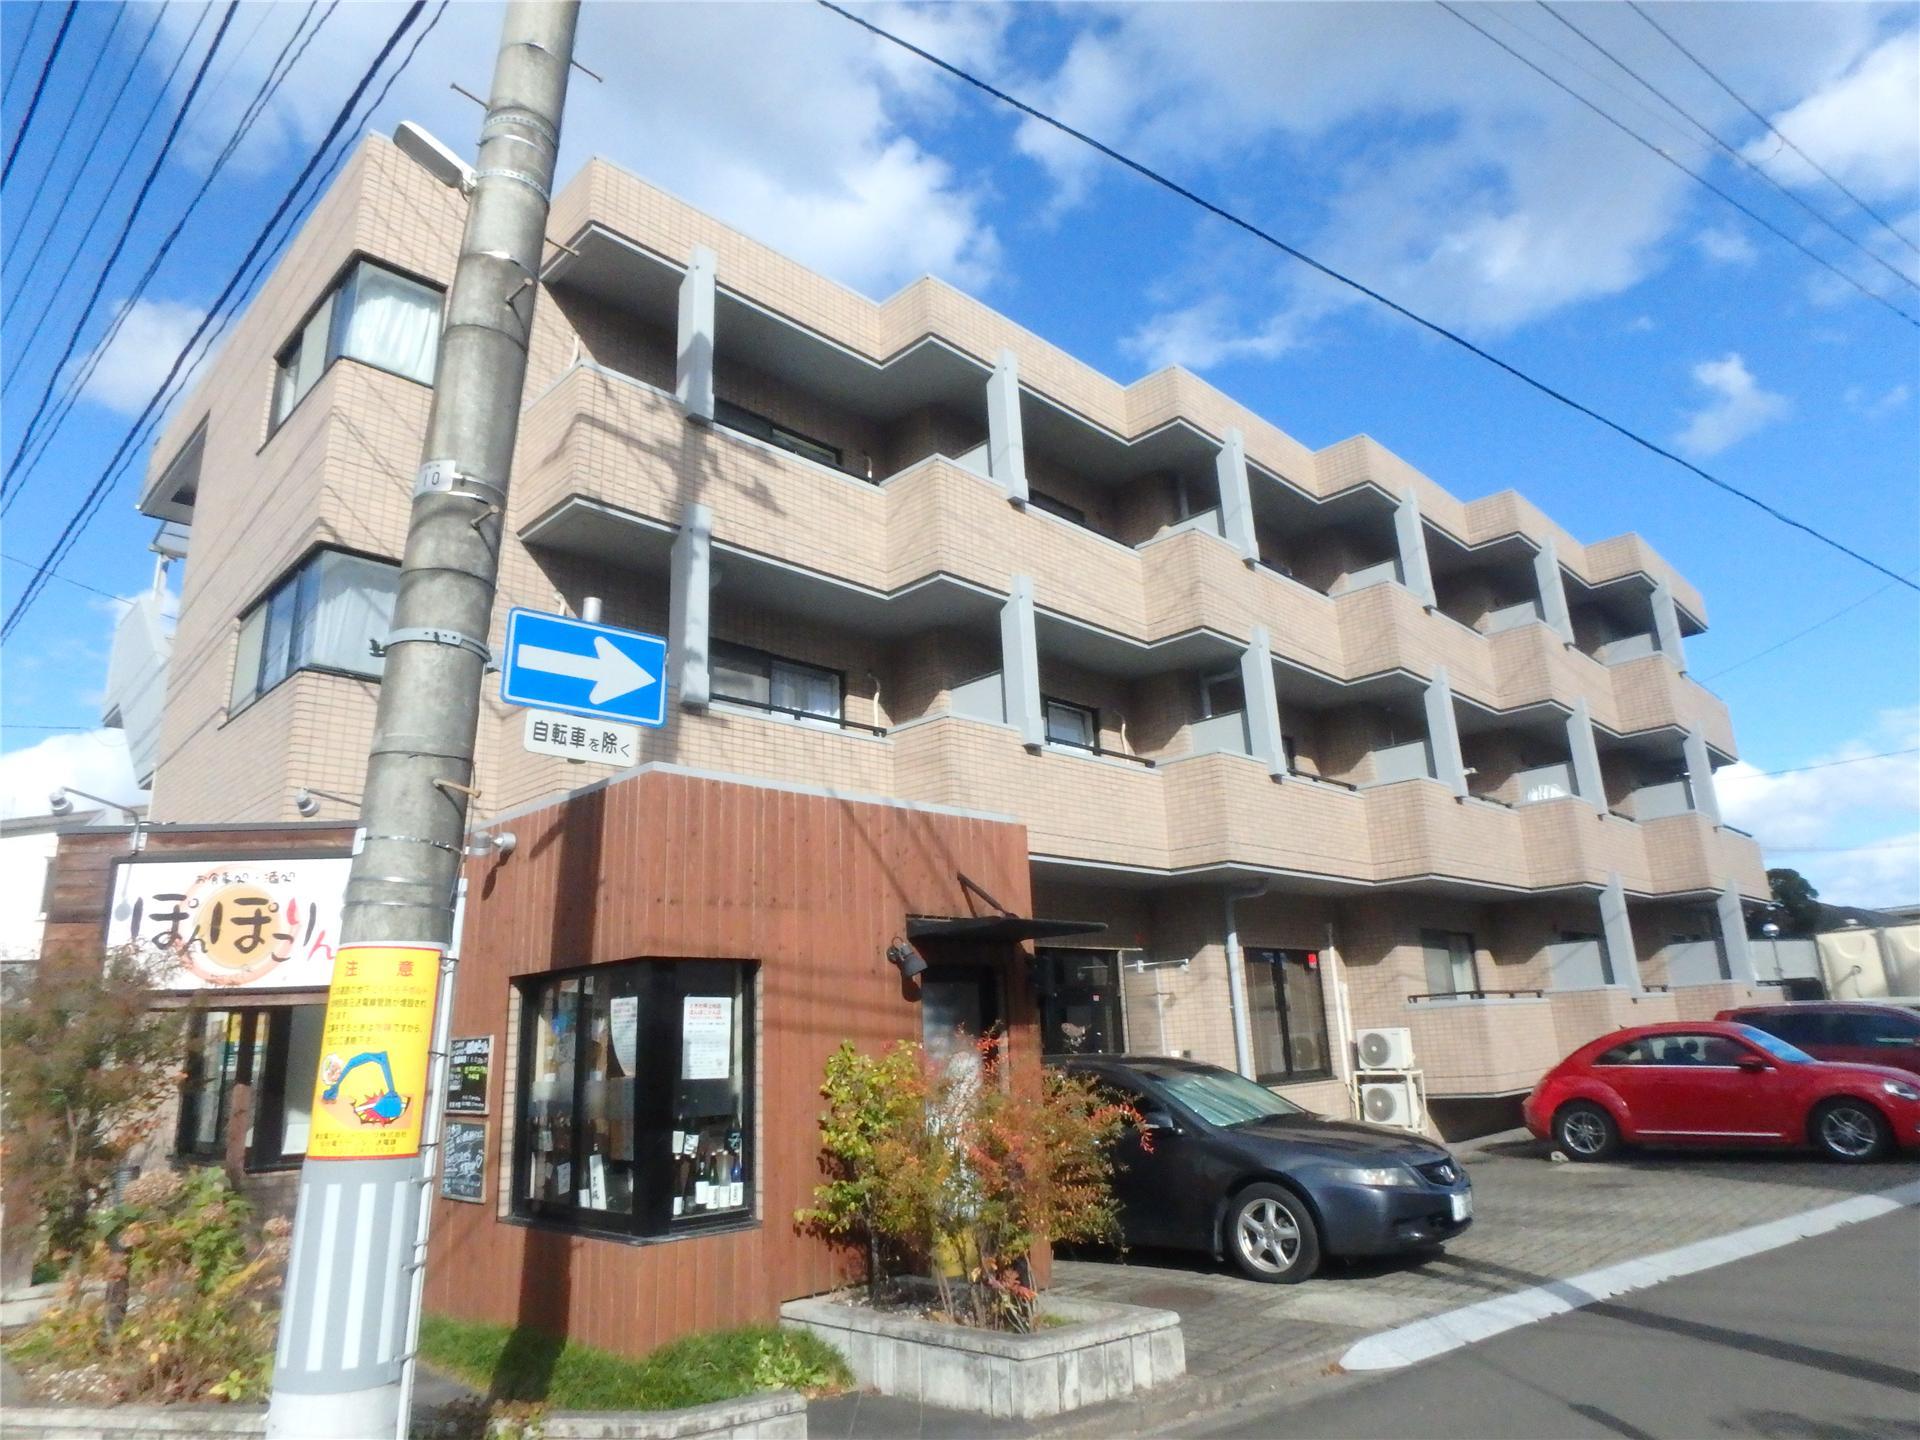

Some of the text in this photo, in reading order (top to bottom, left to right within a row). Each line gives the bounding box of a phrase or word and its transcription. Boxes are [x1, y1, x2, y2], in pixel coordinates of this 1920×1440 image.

[532, 720, 630, 758] 自転車を除く
[130, 893, 335, 963] ぽんぽこりん
